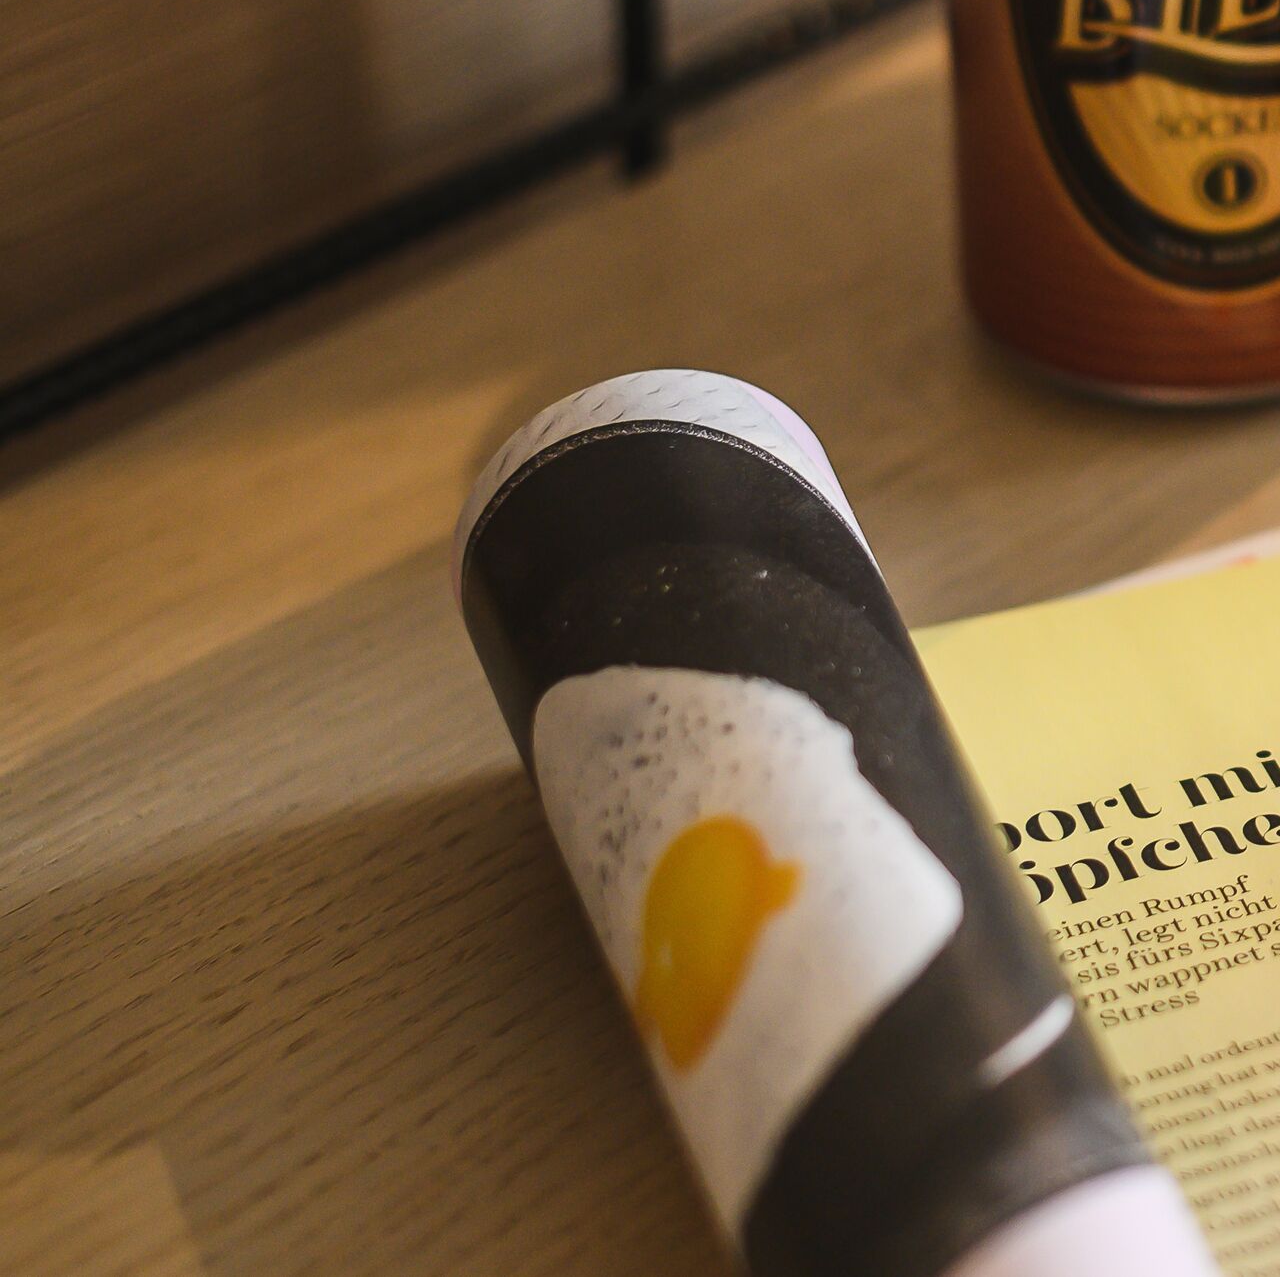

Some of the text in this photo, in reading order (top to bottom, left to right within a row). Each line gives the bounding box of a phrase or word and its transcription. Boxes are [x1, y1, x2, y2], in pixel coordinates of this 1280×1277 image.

[1140, 875, 1252, 918] Rumpf
[1060, 936, 1120, 963] ert,
[1121, 917, 1188, 947] legt
[1192, 893, 1278, 929] nicht
[1077, 961, 1121, 985] sis
[1125, 940, 1194, 972] fürs
[1126, 947, 1265, 996] wappnet
[1099, 988, 1201, 1028] Stress
[1145, 1053, 1196, 1082] mal
[1217, 1064, 1259, 1087] hat
